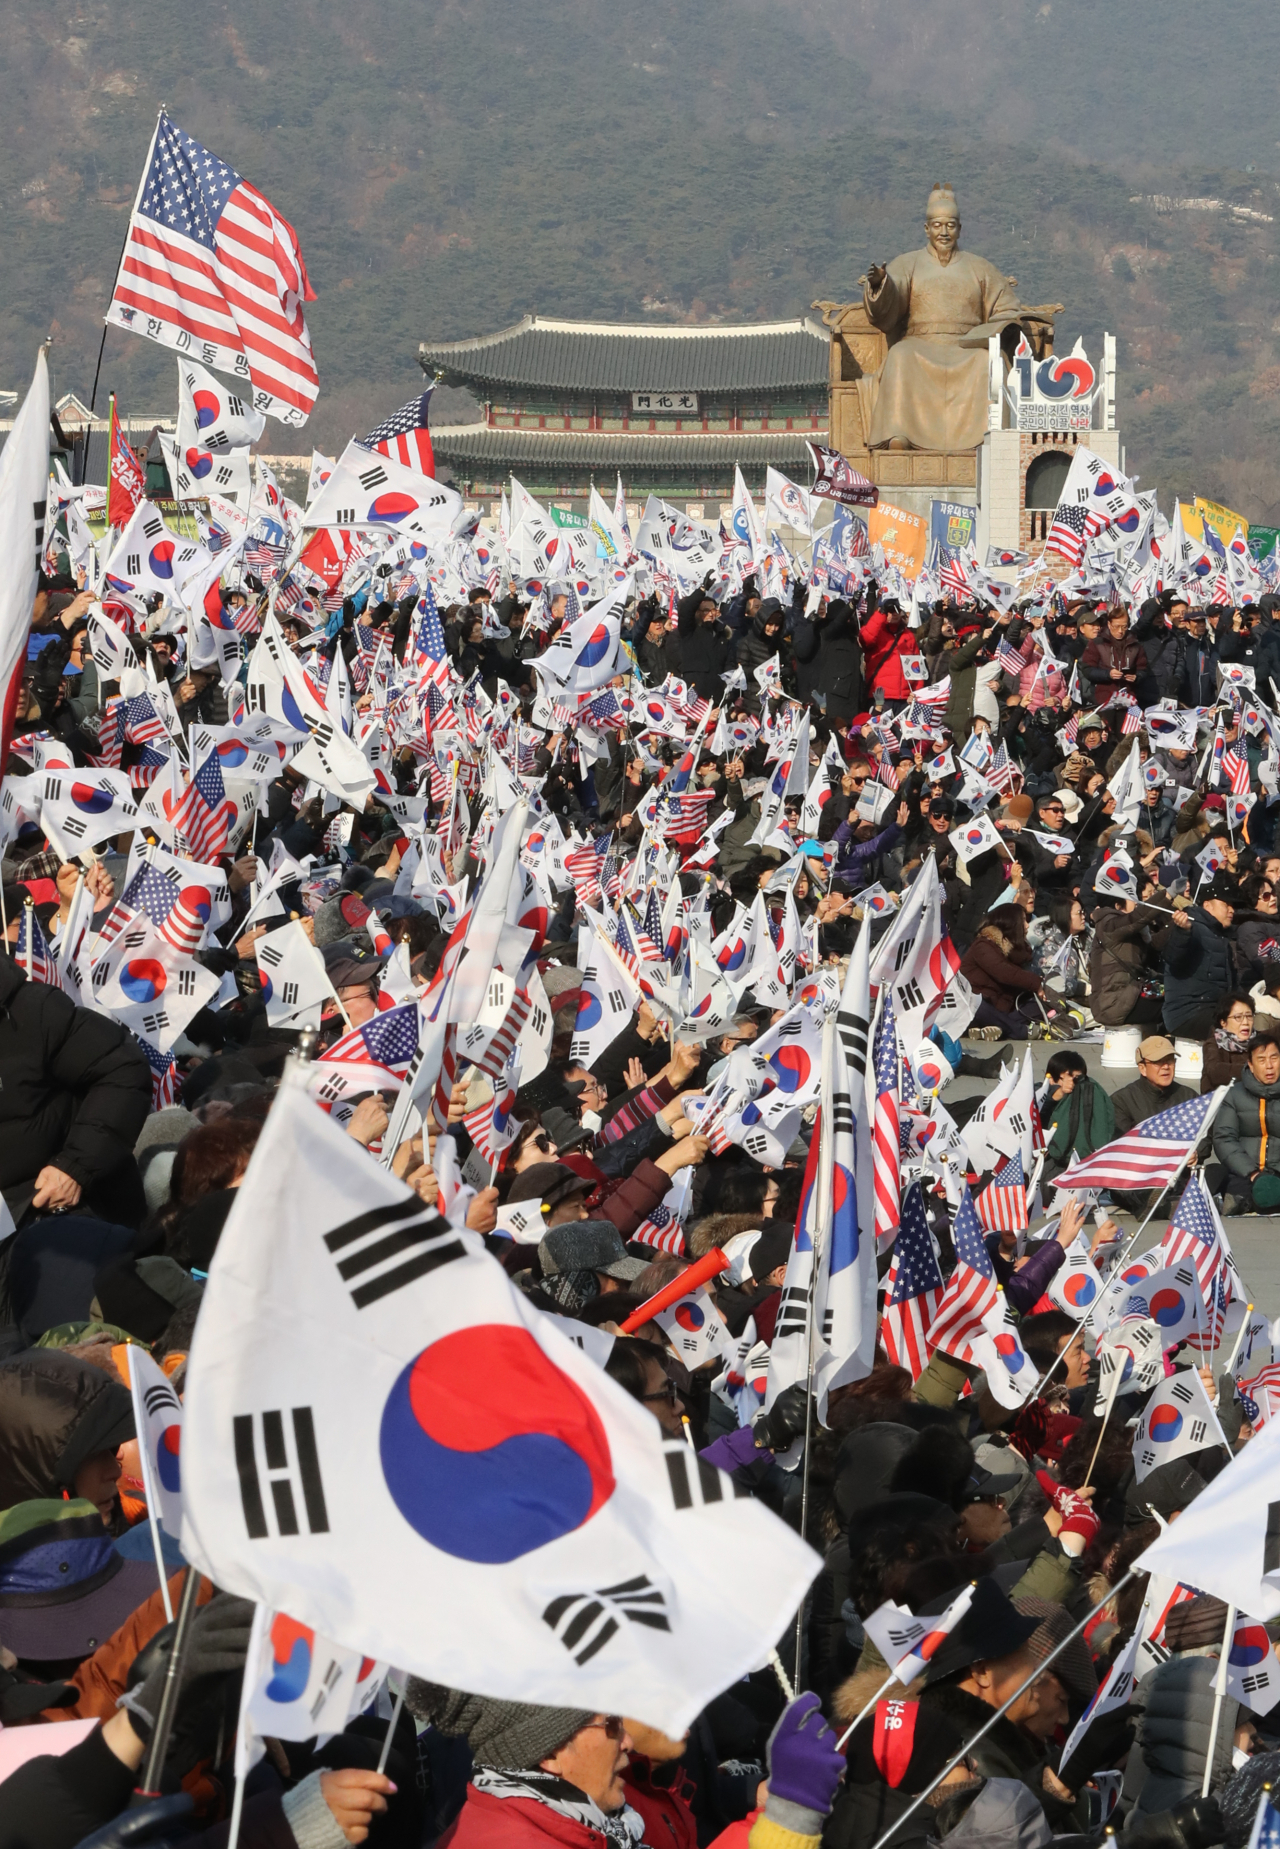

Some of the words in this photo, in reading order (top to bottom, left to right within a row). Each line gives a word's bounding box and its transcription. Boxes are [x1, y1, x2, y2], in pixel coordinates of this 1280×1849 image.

[1019, 404, 1047, 416] 국민이
[1070, 403, 1090, 416] 역사
[1019, 418, 1047, 429] 국민이
[1070, 418, 1090, 428] 나라
